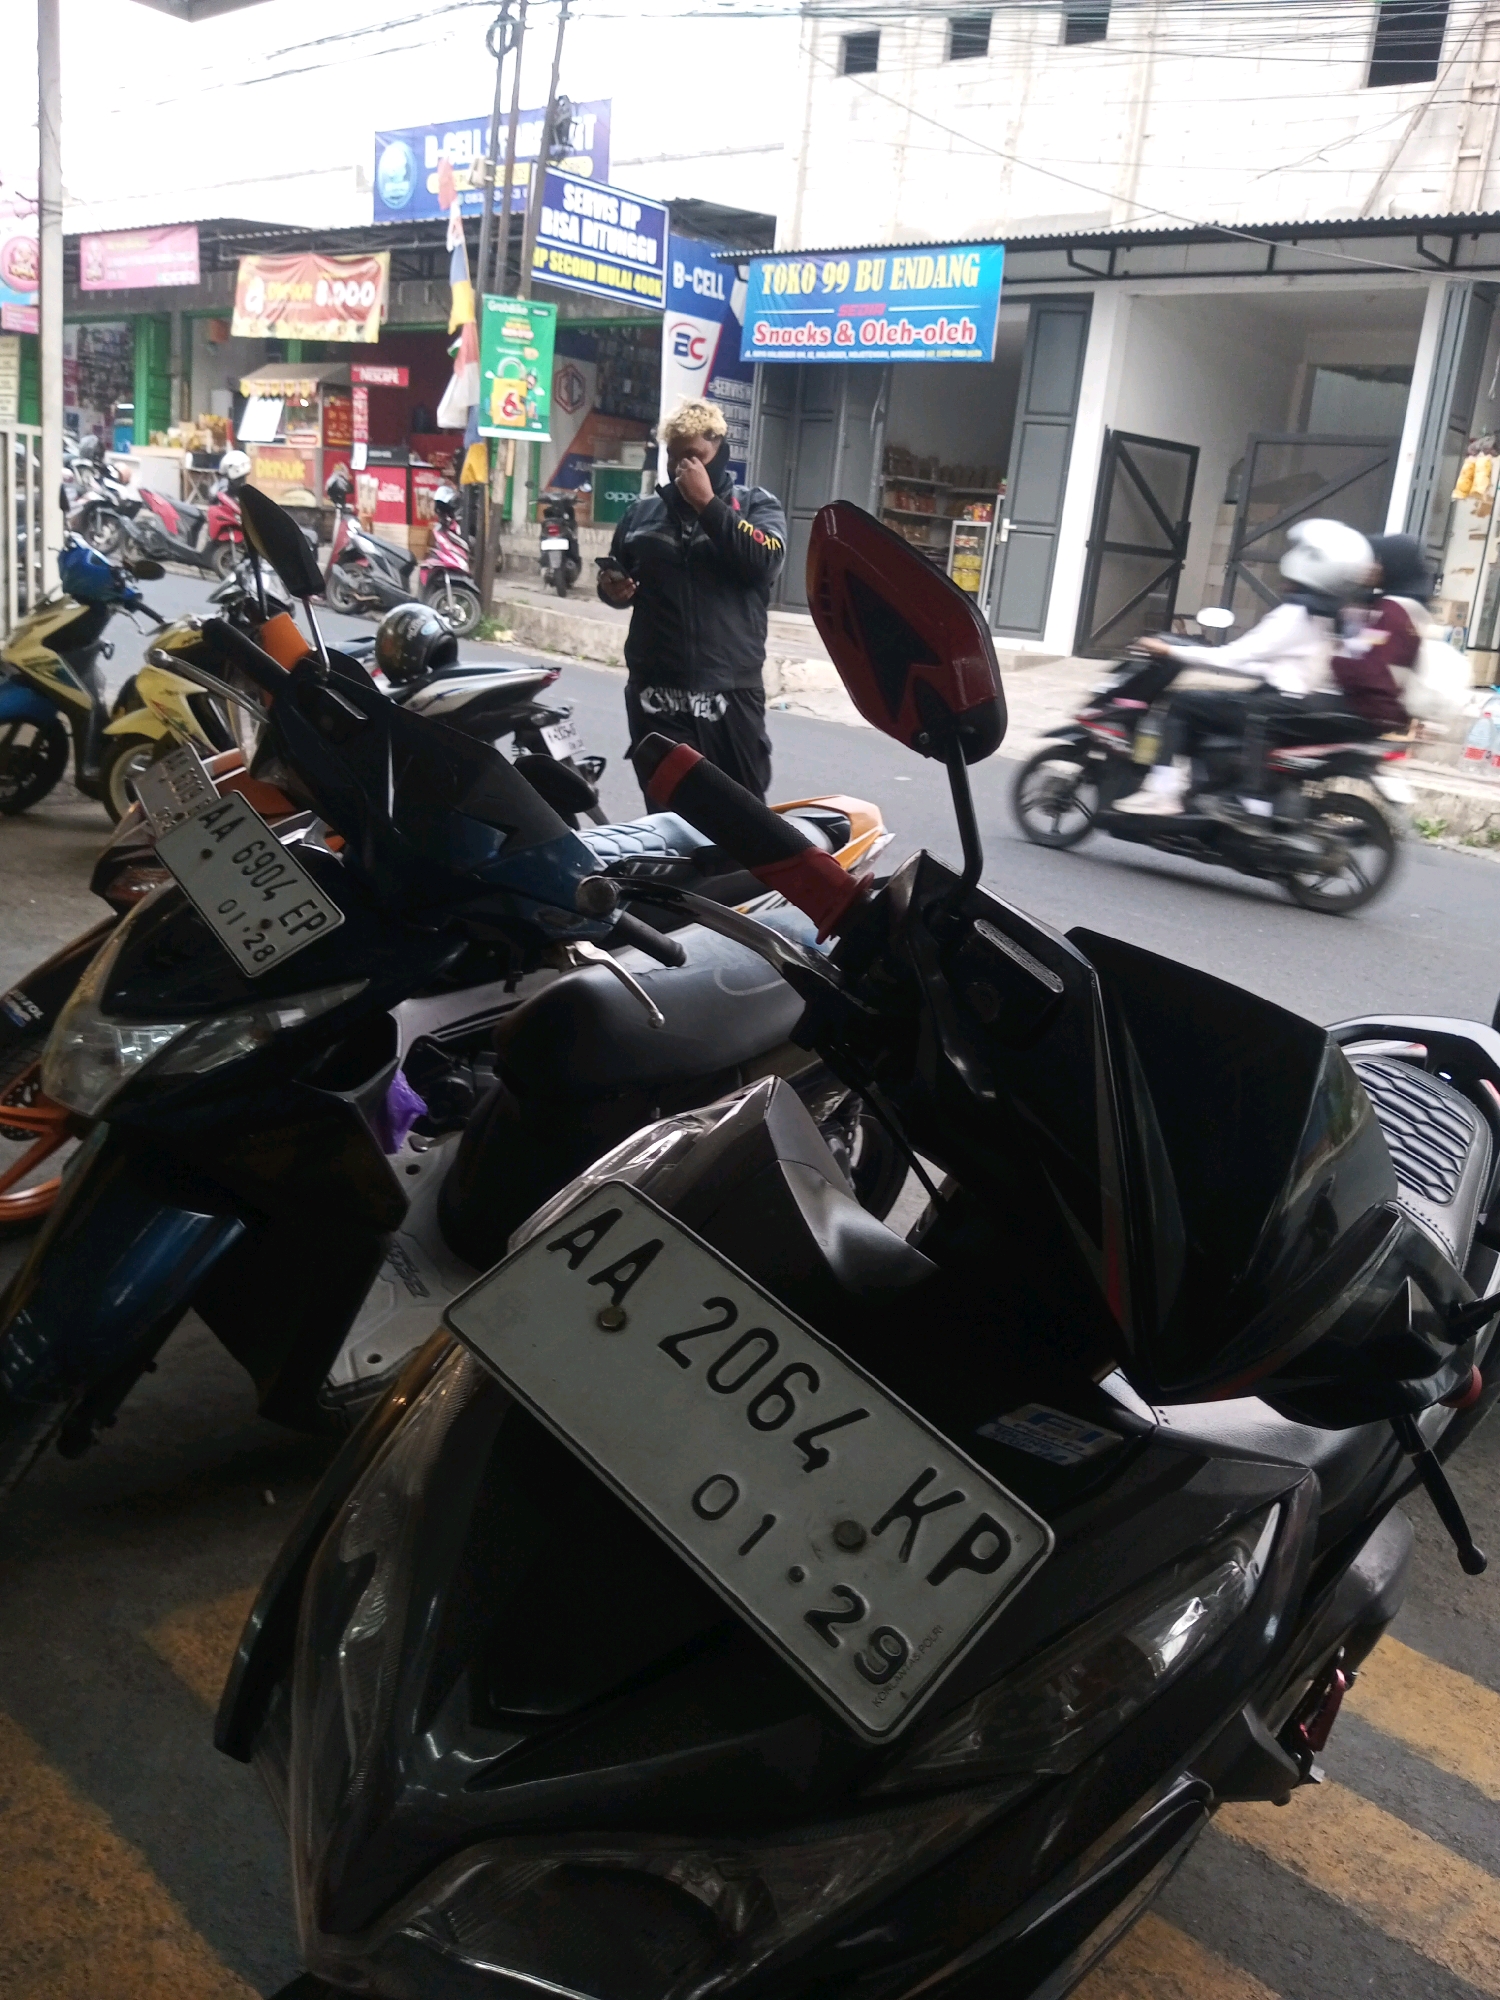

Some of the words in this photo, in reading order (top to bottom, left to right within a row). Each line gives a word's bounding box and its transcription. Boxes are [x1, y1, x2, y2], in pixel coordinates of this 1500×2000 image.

[563, 183, 619, 225] SERVIS
[620, 200, 641, 230] HP
[540, 206, 580, 244] BISA
[581, 218, 657, 265] DITUNGGU
[549, 250, 596, 281] SECOND
[597, 263, 633, 291] MULAI
[672, 260, 726, 301] B-CELL
[762, 263, 816, 295] TOKO
[821, 261, 850, 294] 99
[854, 258, 887, 293] BU
[889, 253, 980, 290] ENDANG
[753, 321, 831, 345] Snacks
[834, 320, 855, 345] &
[860, 316, 977, 345] Oleh-oleh
[198, 803, 246, 843] AA
[232, 840, 298, 902] 6904
[278, 899, 327, 936] EP
[547, 1208, 664, 1306] AA
[657, 1296, 870, 1473] 2064
[871, 1467, 1012, 1587] KP
[918, 1625, 944, 1654] POLRI
